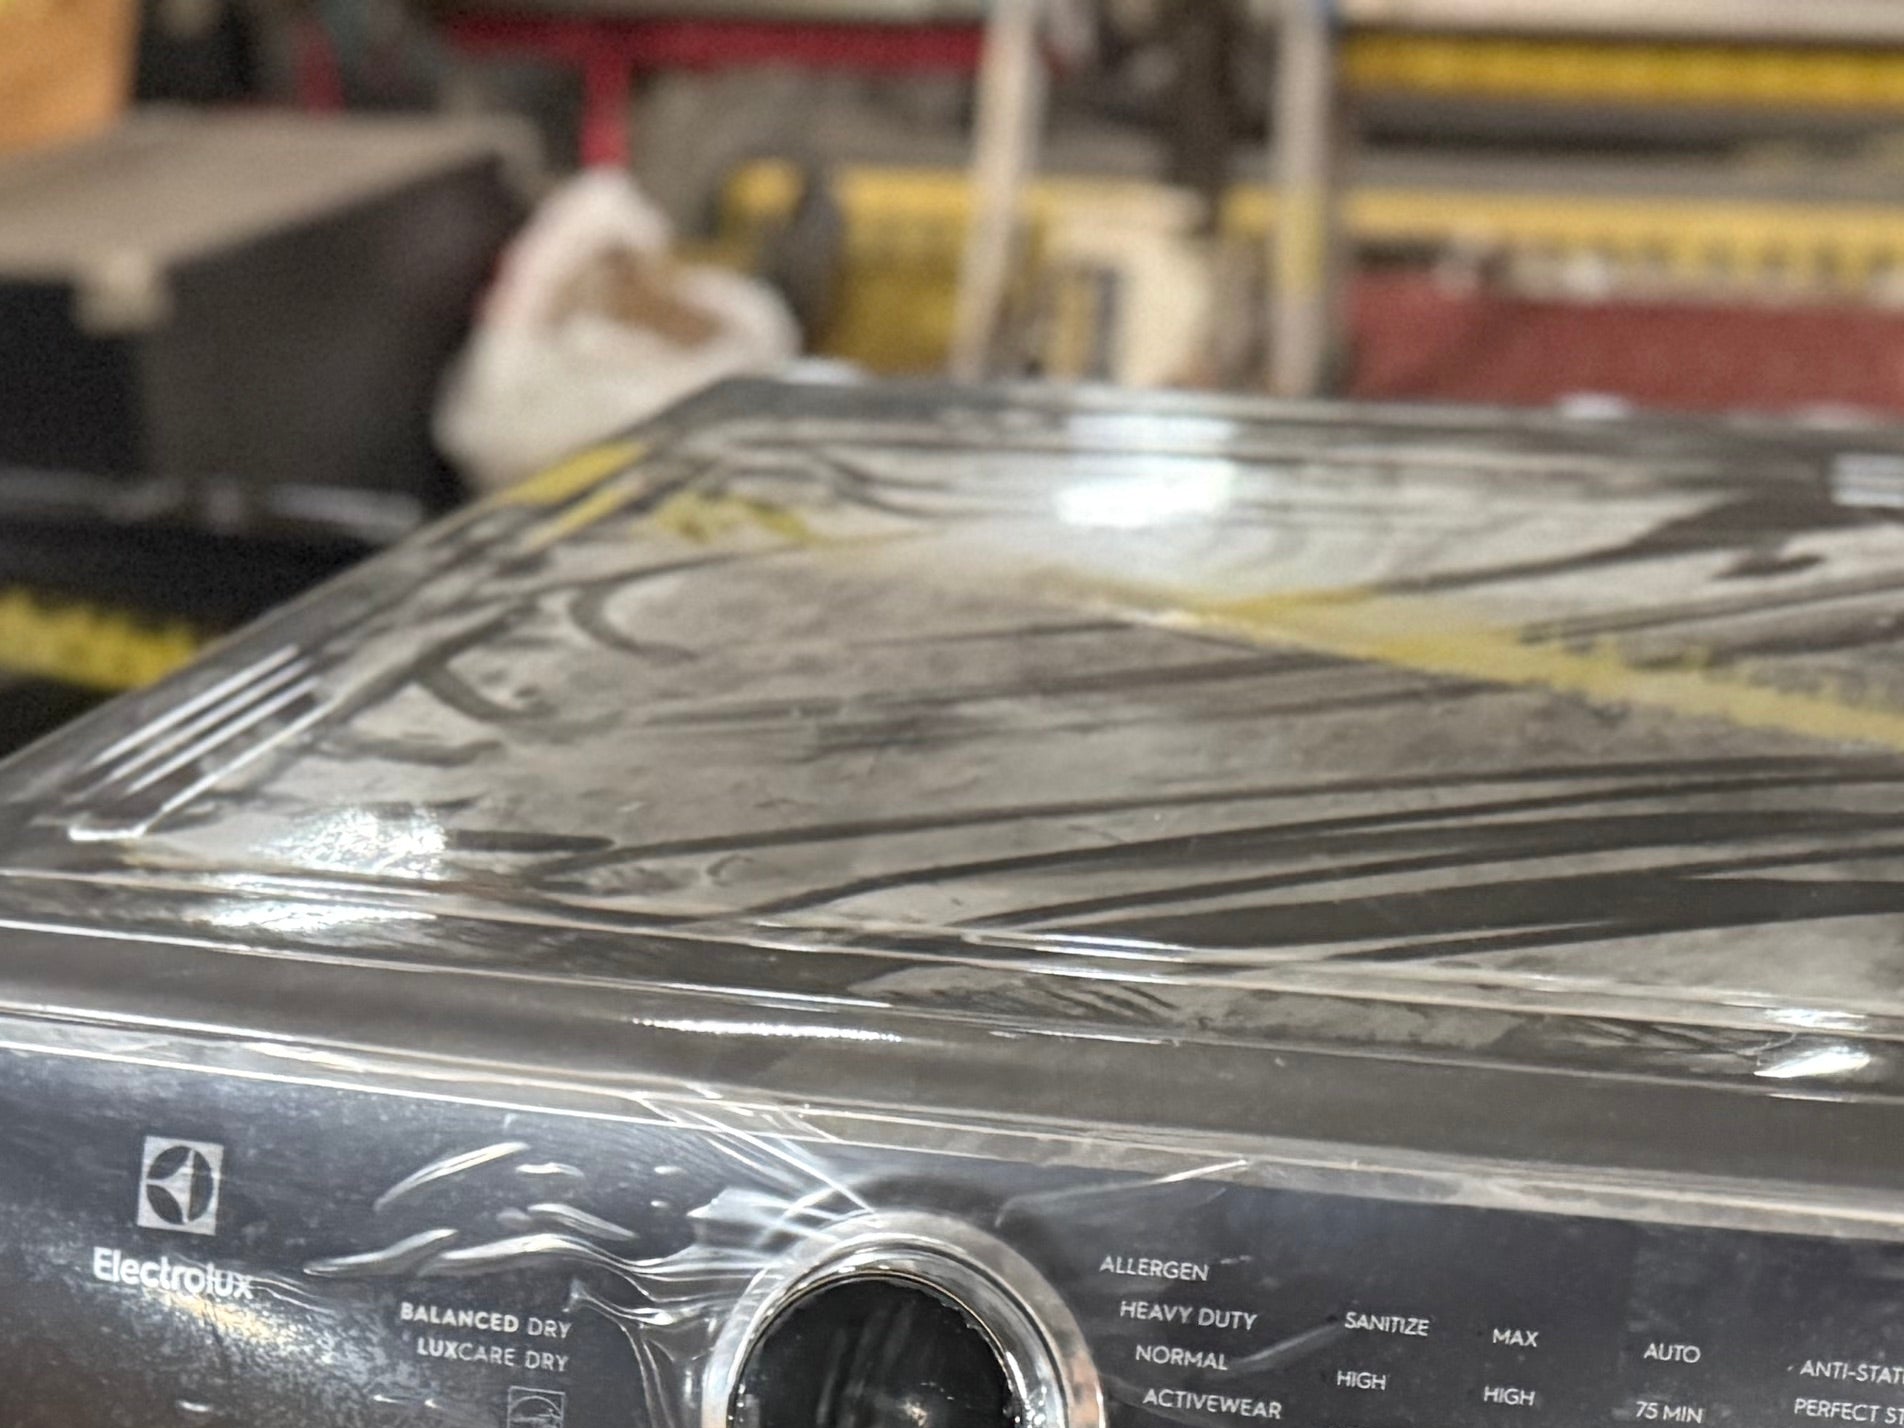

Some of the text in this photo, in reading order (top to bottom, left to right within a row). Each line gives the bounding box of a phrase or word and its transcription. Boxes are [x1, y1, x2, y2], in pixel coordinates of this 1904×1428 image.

[93, 1246, 254, 1299] Electrolux
[1099, 1256, 1210, 1281] ALLERGEN
[400, 1302, 572, 1339] BALANCED DRY
[1120, 1300, 1258, 1330] HEAVY DUTY
[1344, 1311, 1430, 1337] SANITIZE
[1493, 1328, 1539, 1348] MAX
[417, 1337, 569, 1372] LUXCARE DRY
[1136, 1344, 1228, 1370] NORMAL
[1643, 1342, 1701, 1363] AUTO
[1337, 1370, 1386, 1390] HIGH
[1142, 1388, 1282, 1419] ACTIVEWEAR
[1483, 1386, 1535, 1406] HIGH
[1636, 1400, 1704, 1424] 75 MIN
[1794, 1398, 1881, 1422] PERFECT
